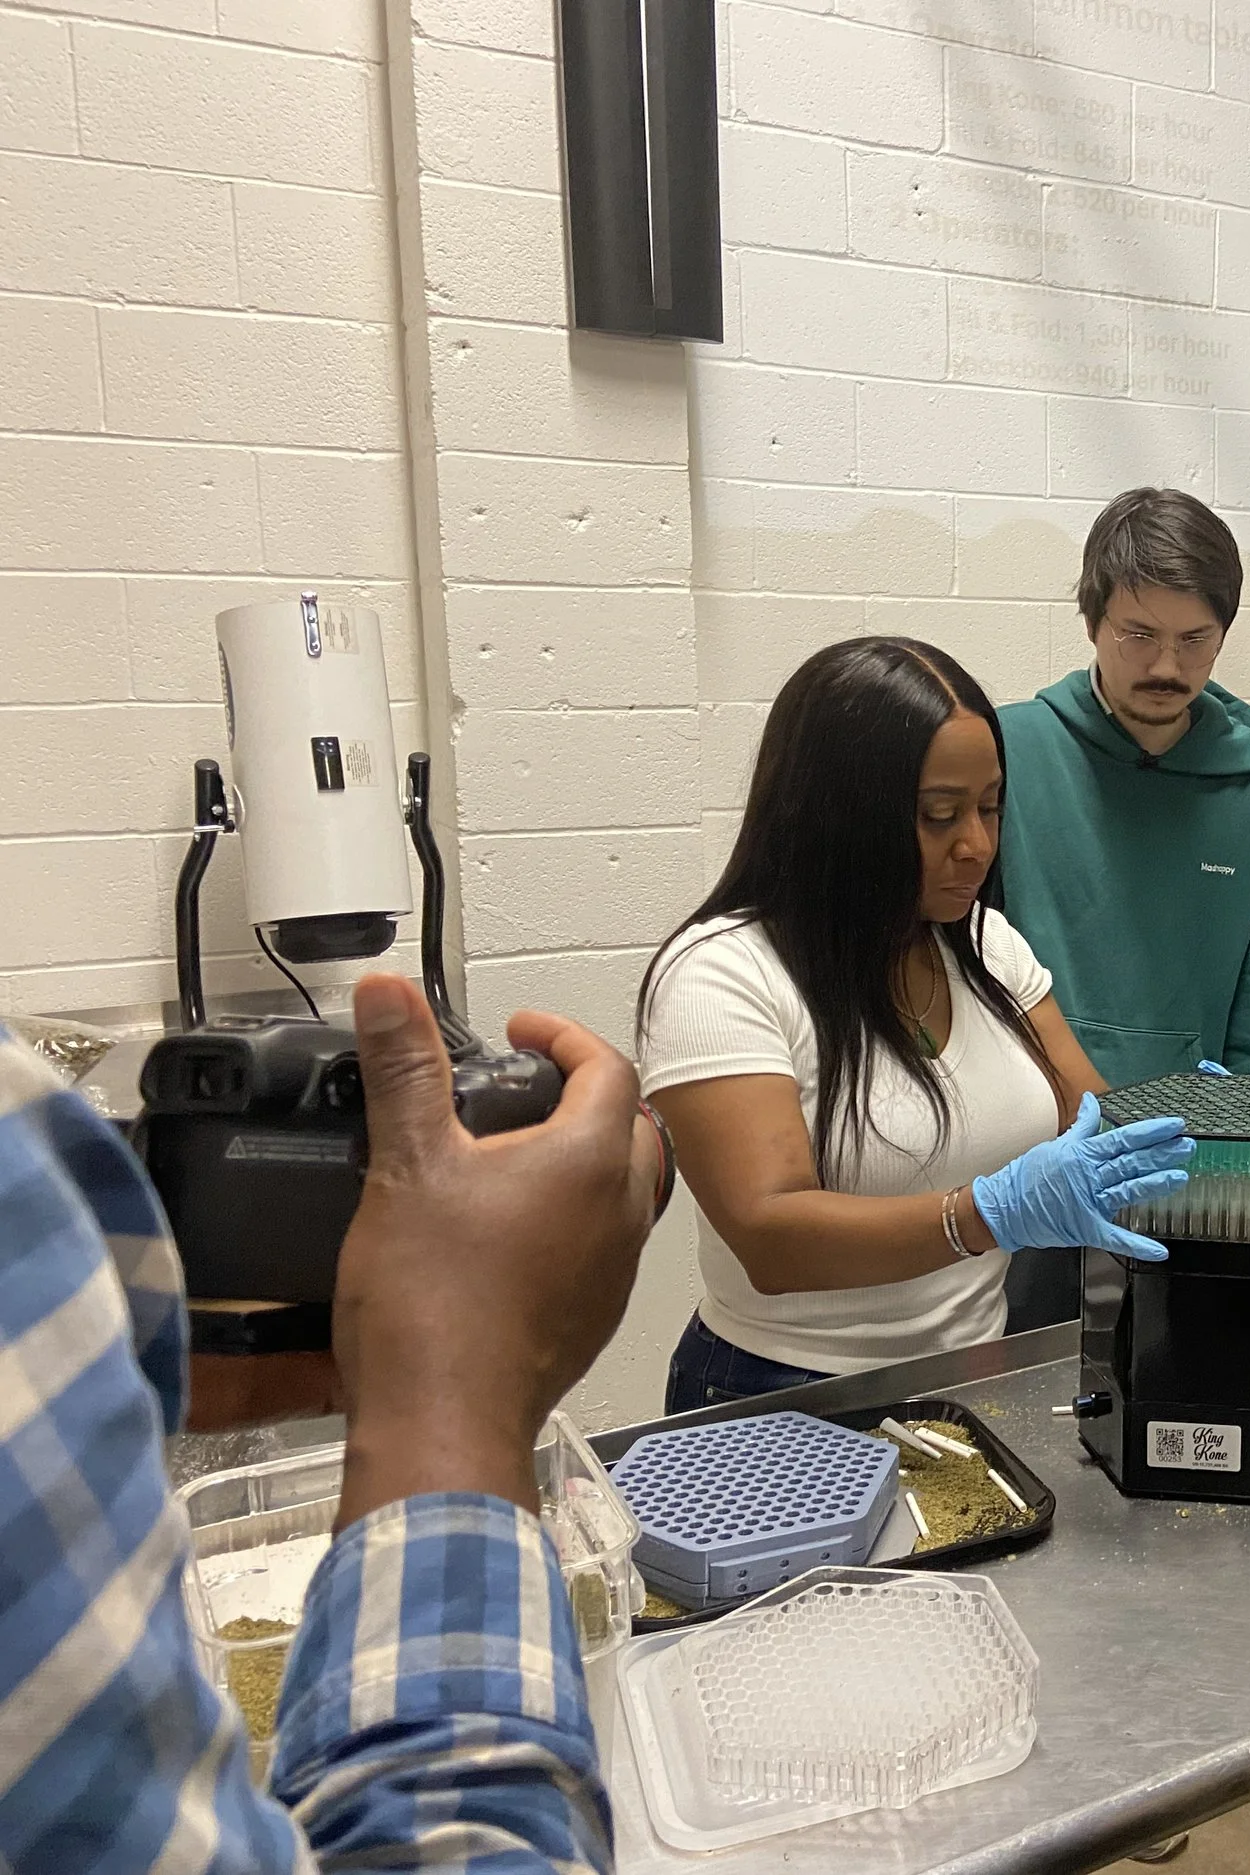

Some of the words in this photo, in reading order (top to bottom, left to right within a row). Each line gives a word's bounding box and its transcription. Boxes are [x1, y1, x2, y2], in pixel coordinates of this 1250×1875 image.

[1121, 112, 1159, 135] per
[1163, 111, 1214, 144] hour
[1121, 154, 1159, 178] per
[1163, 154, 1214, 185] hour
[1073, 185, 1116, 214] 520
[1121, 198, 1160, 221] per
[1164, 200, 1216, 228] hour
[1011, 313, 1070, 343] Fold:
[1074, 322, 1136, 348] 1,300
[1142, 333, 1178, 355] per
[1182, 332, 1231, 360] hour
[1075, 362, 1117, 389] 940
[1121, 373, 1158, 393] per
[1163, 370, 1213, 397] hour
[1192, 1427, 1225, 1448] King
[1194, 1443, 1228, 1461] Kone
[1158, 1454, 1182, 1463] 00253
